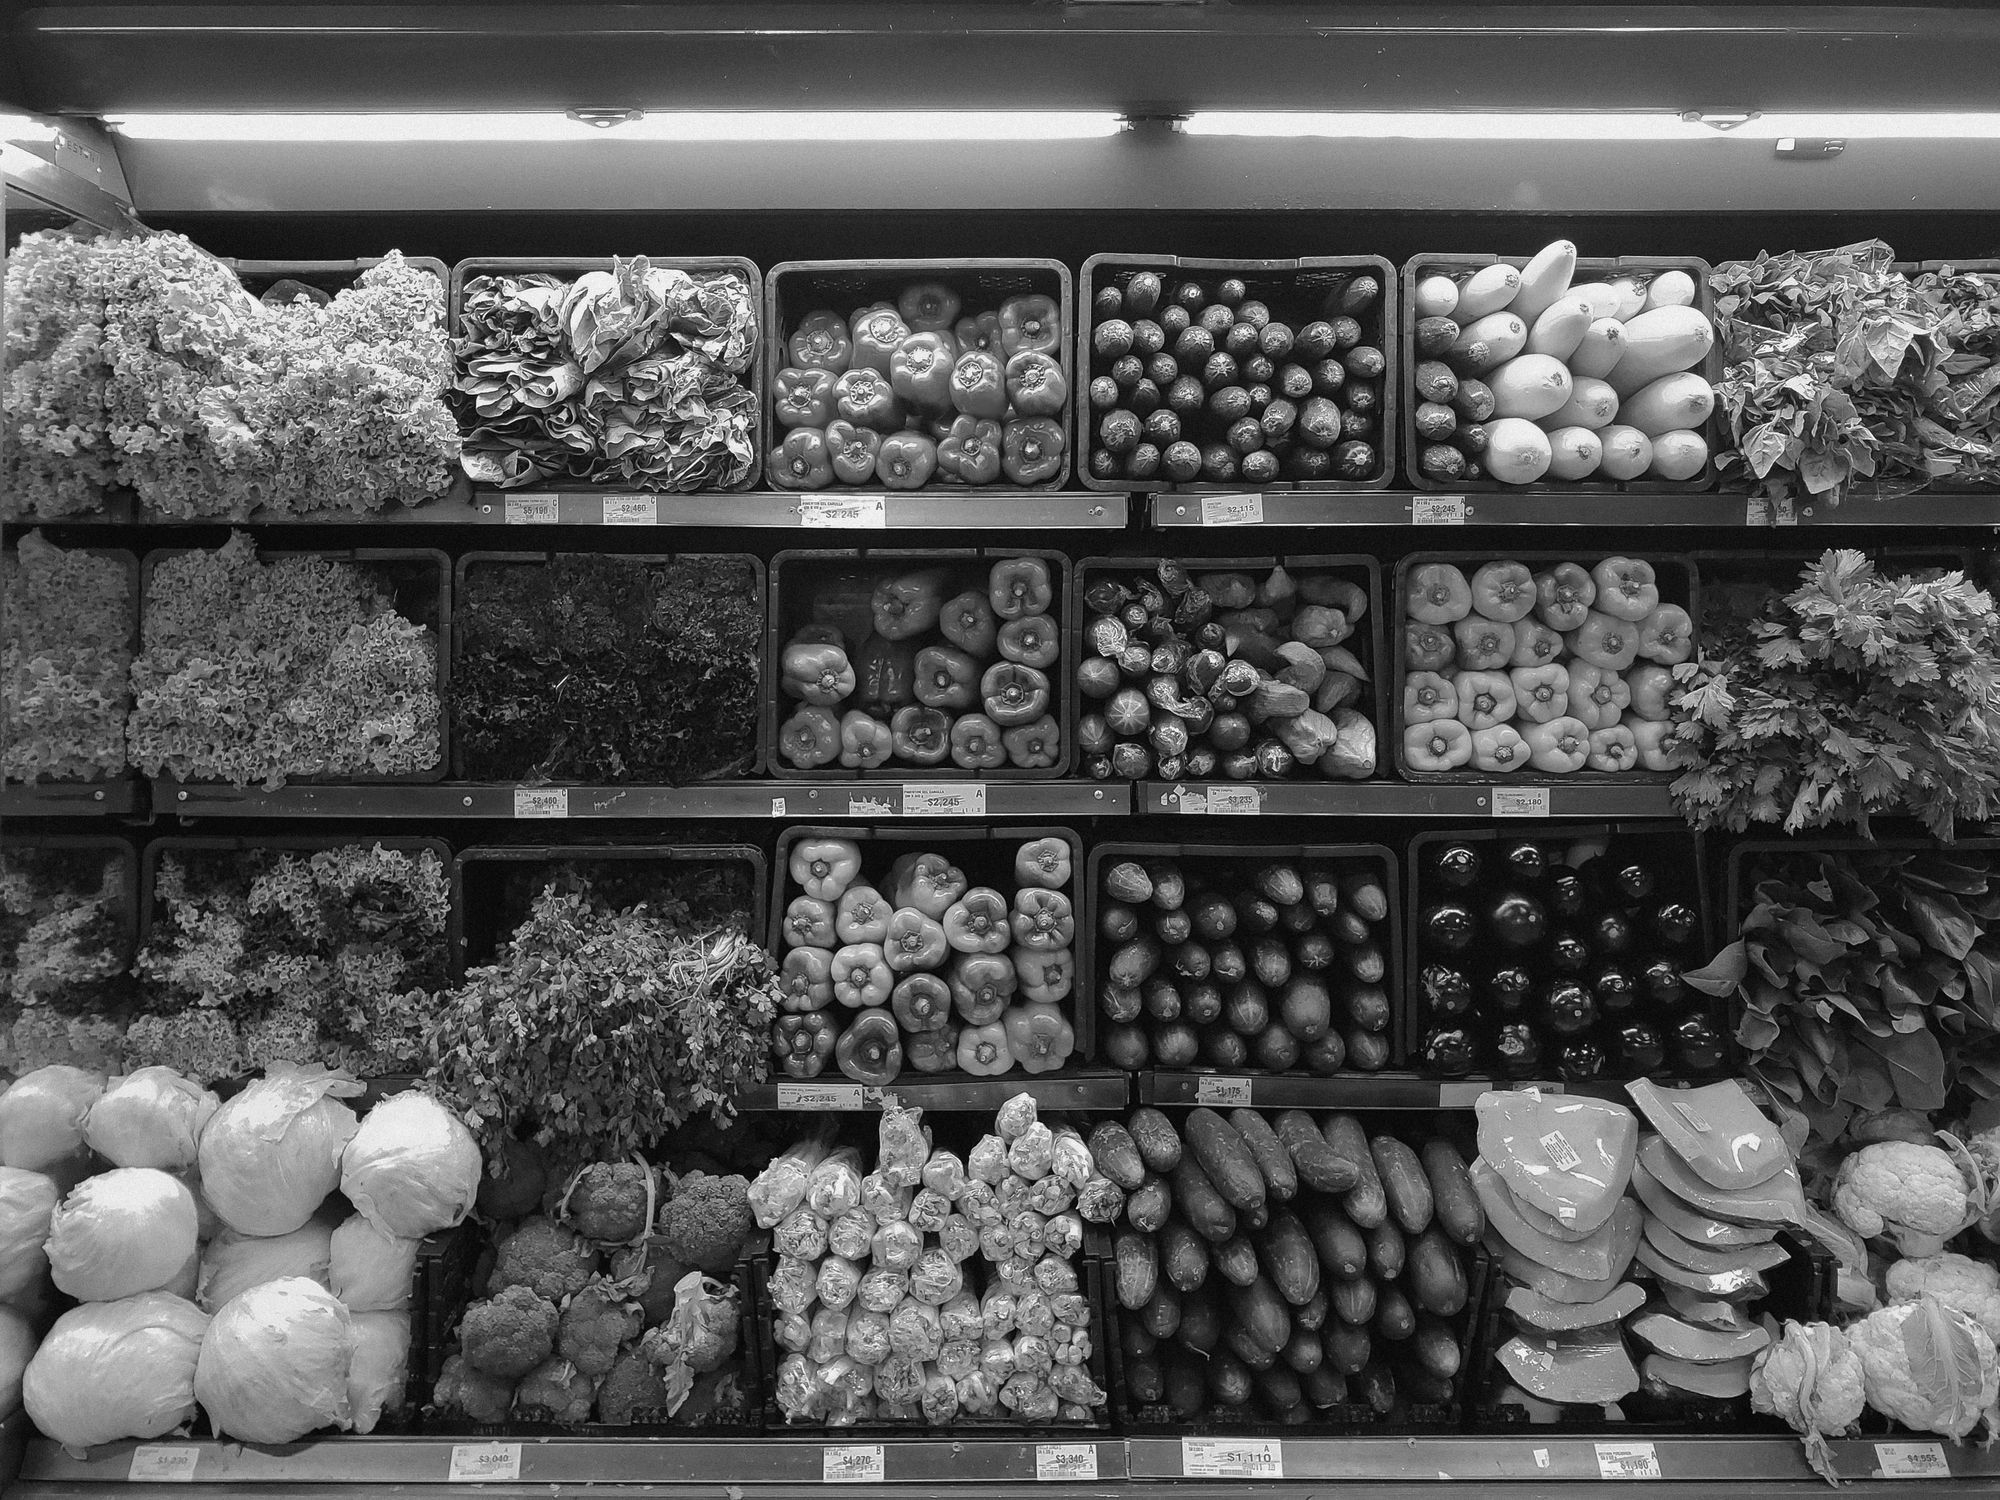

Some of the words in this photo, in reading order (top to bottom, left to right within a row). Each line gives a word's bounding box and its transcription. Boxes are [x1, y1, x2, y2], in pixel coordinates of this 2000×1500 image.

[650, 496, 656, 505] C
[621, 504, 647, 513] $2,460
[875, 501, 883, 510] A
[1227, 504, 1254, 513] $2,115
[1431, 504, 1456, 514] $2,245
[561, 789, 567, 797] C
[975, 789, 983, 798] A
[532, 796, 557, 806] $2,460
[927, 798, 960, 807] $2,245
[1515, 798, 1542, 806] $2,180
[1245, 1079, 1250, 1087] A
[803, 1095, 837, 1103] $2,245
[876, 1445, 881, 1455] B
[1088, 1444, 1094, 1454] A
[1263, 1444, 1270, 1453] A
[478, 1454, 509, 1464] $3,040
[842, 1455, 871, 1467] $4,270
[1055, 1454, 1084, 1465] $3,340
[1227, 1452, 1272, 1463] $1,110
